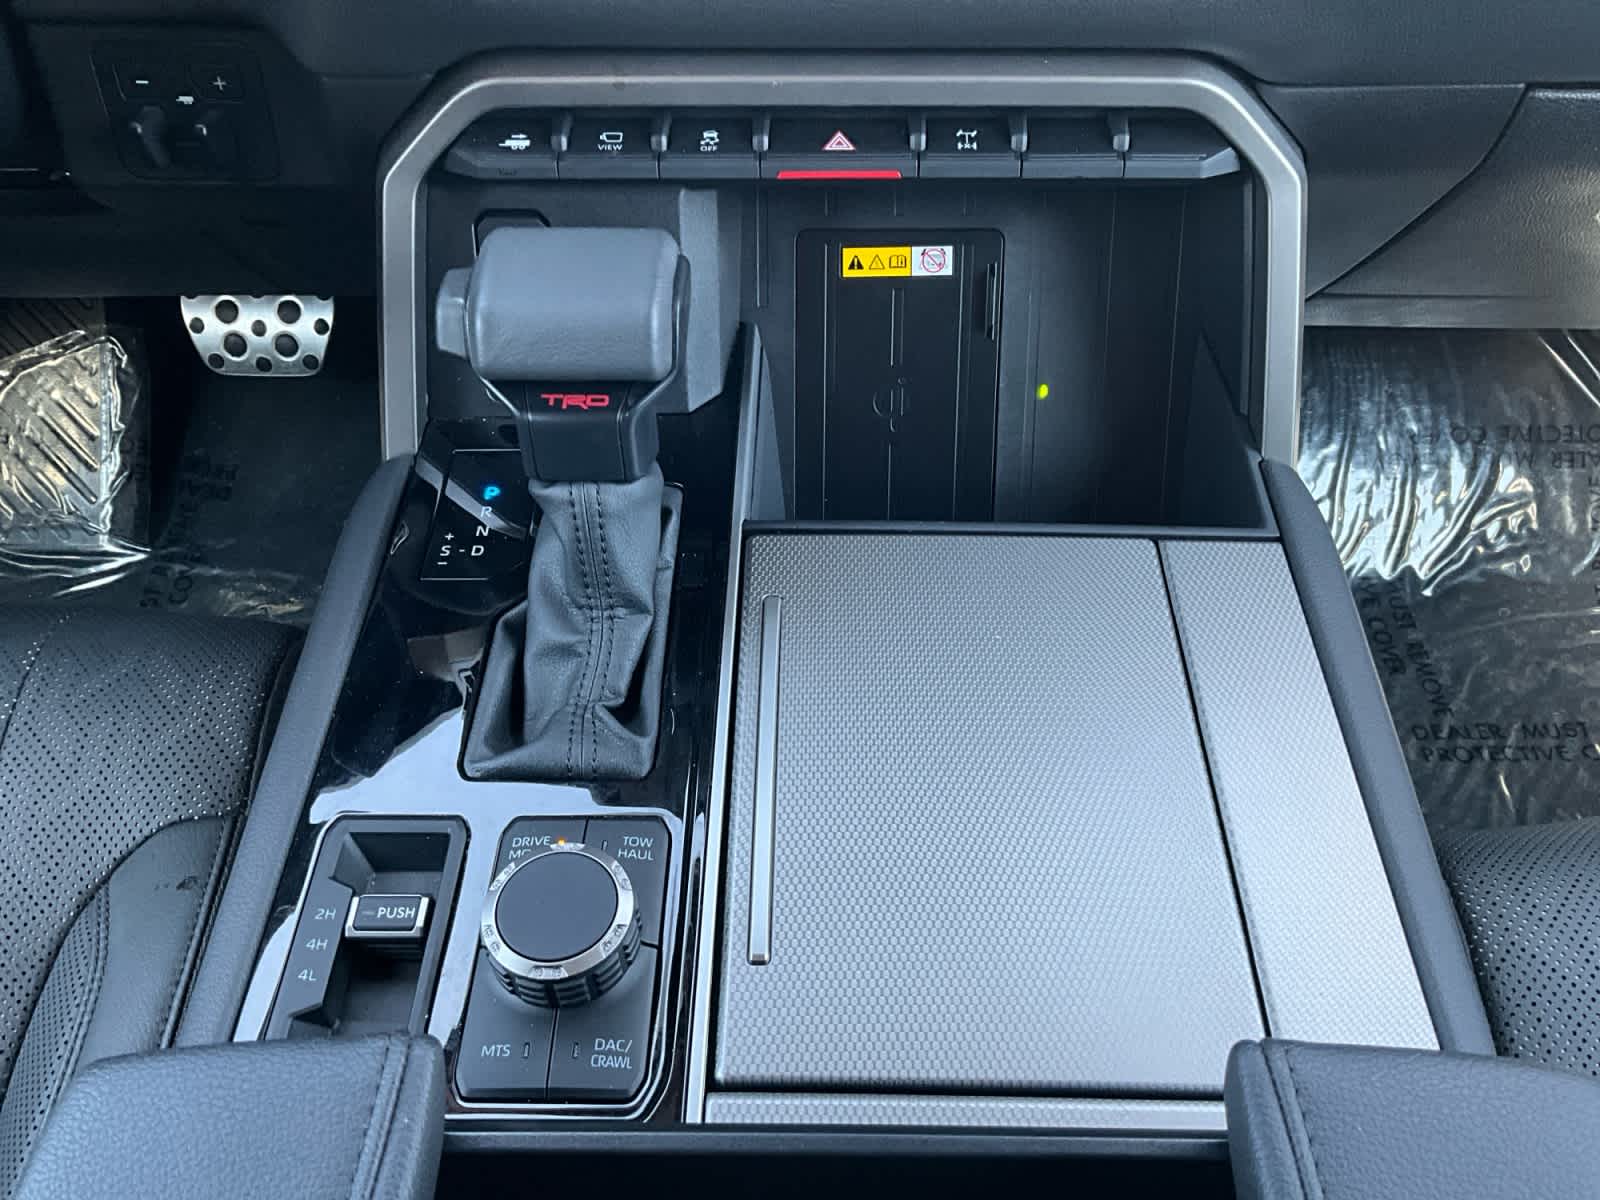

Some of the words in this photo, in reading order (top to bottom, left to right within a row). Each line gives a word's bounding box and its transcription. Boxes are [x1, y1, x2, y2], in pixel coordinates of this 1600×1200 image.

[700, 144, 718, 152] OFF
[541, 394, 609, 409] TRD
[484, 486, 501, 500] P
[480, 506, 493, 518] R
[475, 526, 490, 537] N
[440, 545, 451, 556] S
[471, 545, 485, 556] D
[512, 835, 552, 848] DRIVE
[623, 836, 654, 848] TOW
[618, 849, 654, 861] HAUL
[314, 908, 337, 921] 2H
[377, 906, 416, 919] PUSH
[306, 938, 329, 951] 4H
[298, 968, 317, 982] 4L
[481, 1044, 511, 1057] MTS
[594, 1038, 633, 1053] DAC/
[591, 1054, 633, 1069] CRAWL
